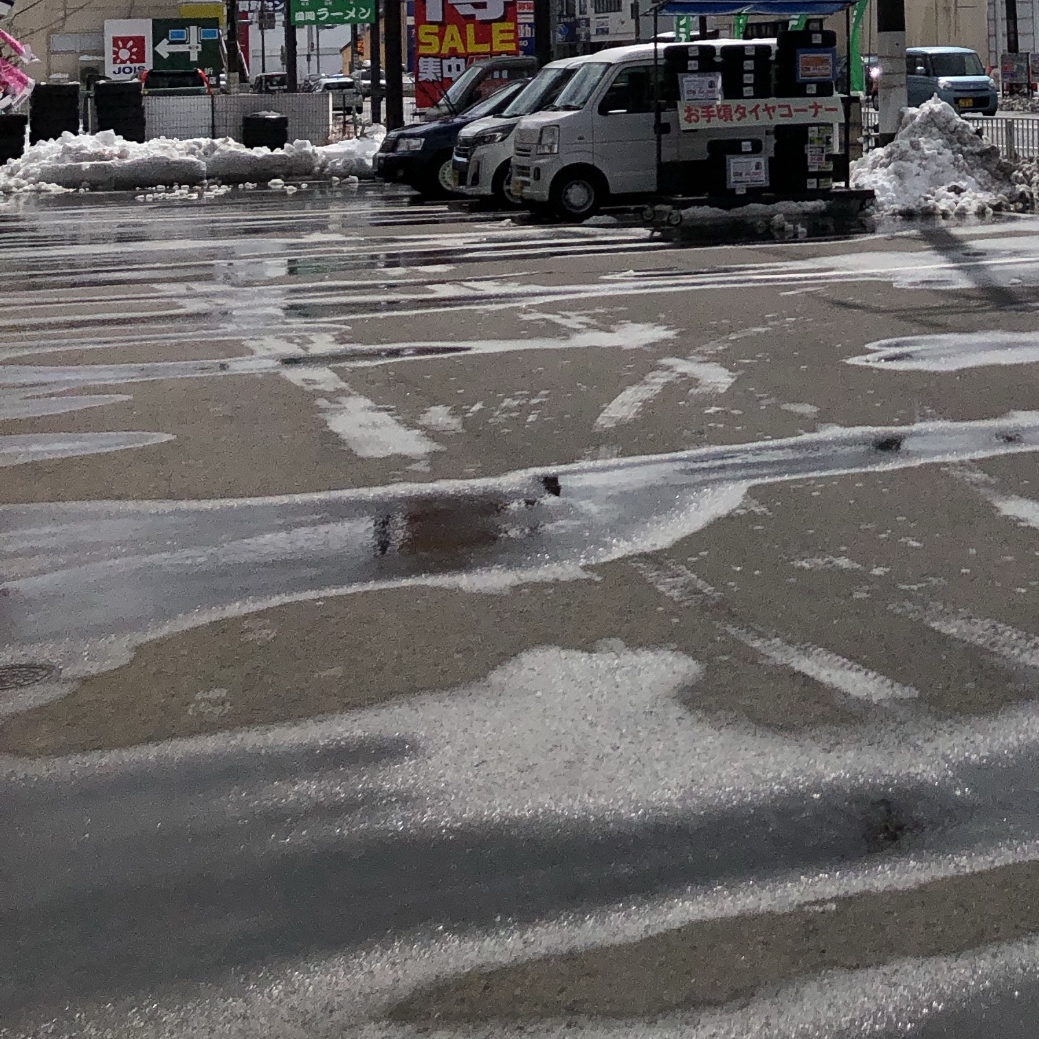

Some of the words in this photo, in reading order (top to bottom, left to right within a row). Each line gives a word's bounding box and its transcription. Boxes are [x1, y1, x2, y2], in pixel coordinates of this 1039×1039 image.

[419, 22, 517, 54] SALE
[683, 102, 839, 124] お手頃タイヤコーナー
